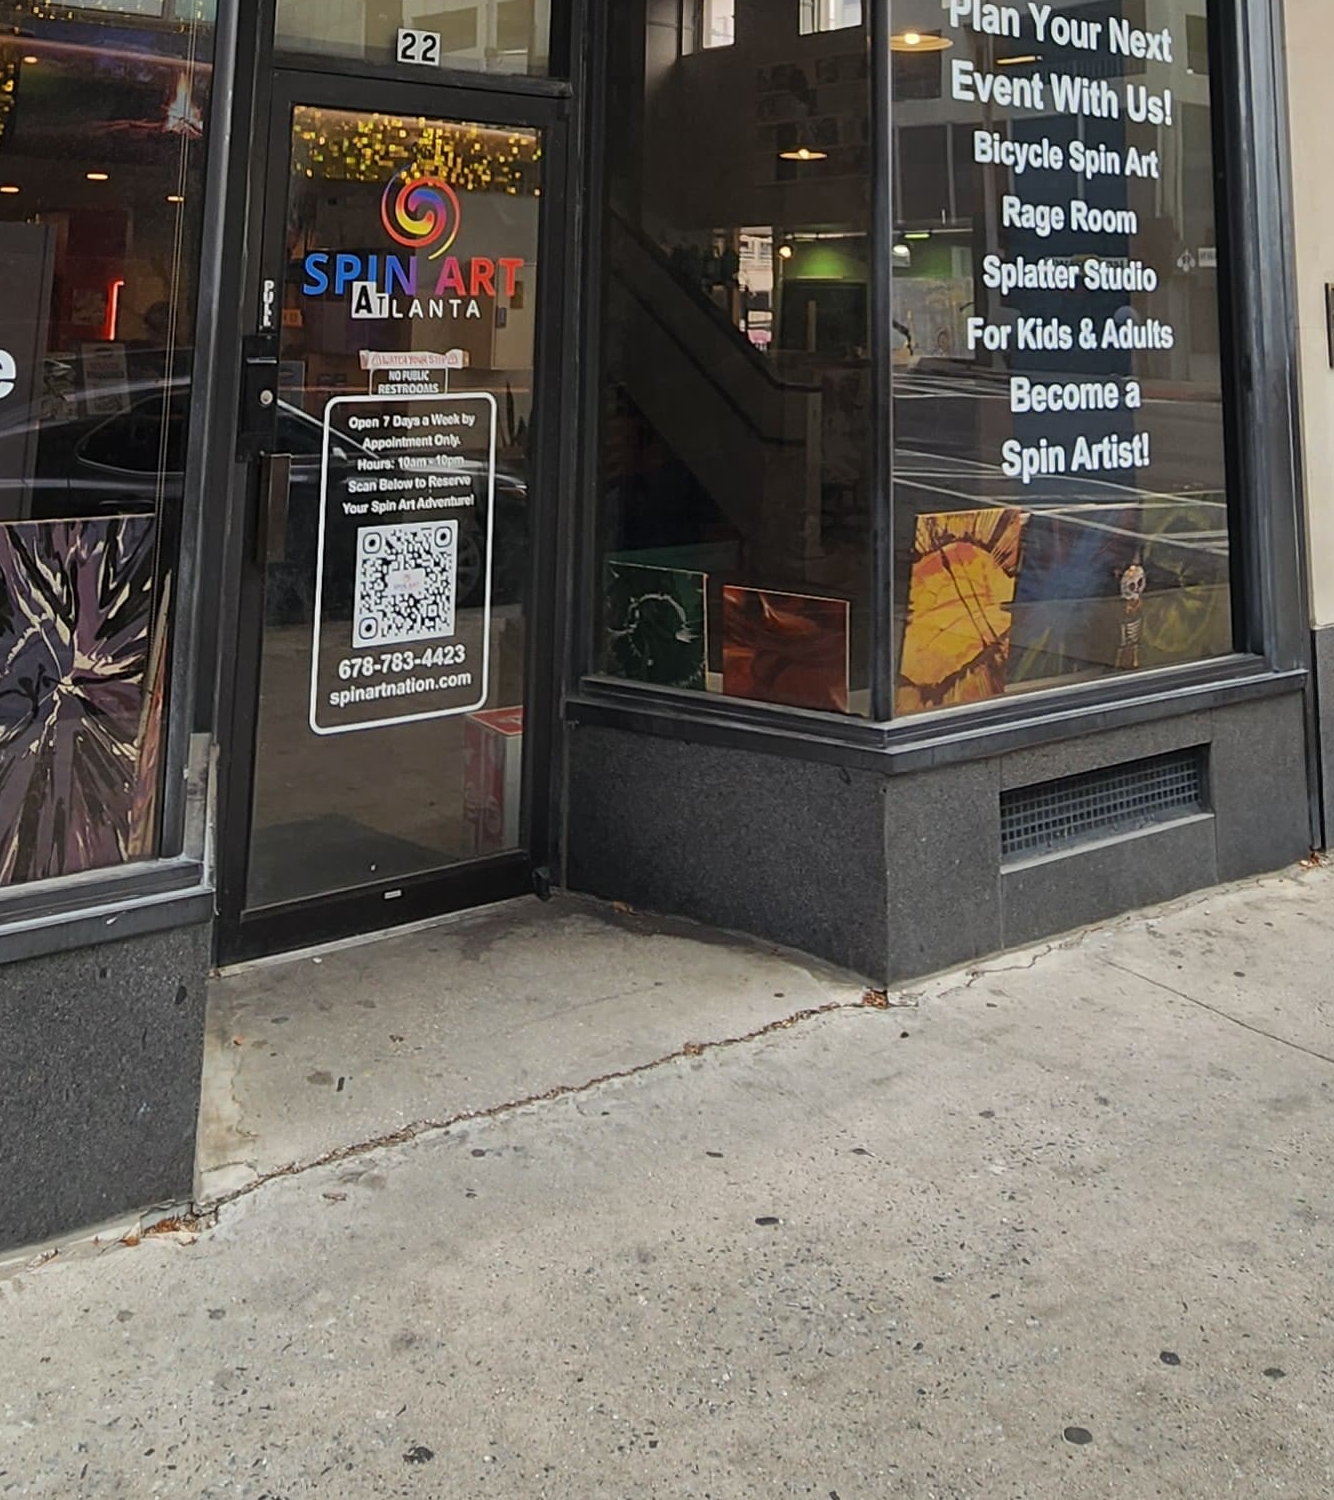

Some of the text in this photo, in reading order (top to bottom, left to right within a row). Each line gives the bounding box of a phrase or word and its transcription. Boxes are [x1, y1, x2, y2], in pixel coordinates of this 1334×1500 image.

[401, 32, 437, 63] 22
[1028, 2, 1102, 50] Your
[1109, 16, 1173, 63] Next
[951, 59, 1172, 126] Event With Us!
[973, 130, 1160, 180] Bicycle Spin Art
[1002, 195, 1137, 237] Rage Room
[302, 253, 524, 297] SPIN ART
[982, 255, 1157, 295] Splatter Studio
[263, 280, 275, 327] PULL
[967, 317, 1174, 350] For Kids & Adults
[378, 383, 439, 394] RESTROOMS
[388, 370, 429, 381] NO PUBLIC
[1010, 376, 1141, 413] Become a
[348, 412, 475, 431] Open 7 Days a Week by
[362, 435, 433, 451] Appointment
[1001, 432, 1150, 484] Spin Artist!
[357, 458, 395, 471] Hours:
[398, 456, 426, 468] 10am
[435, 454, 465, 468] 10pm
[348, 475, 471, 493] Scan Below to Reserve
[342, 494, 475, 515] Your Spin Art Adventure!
[338, 644, 466, 680] 678-783-4423
[329, 672, 472, 708] spinartnation.com
